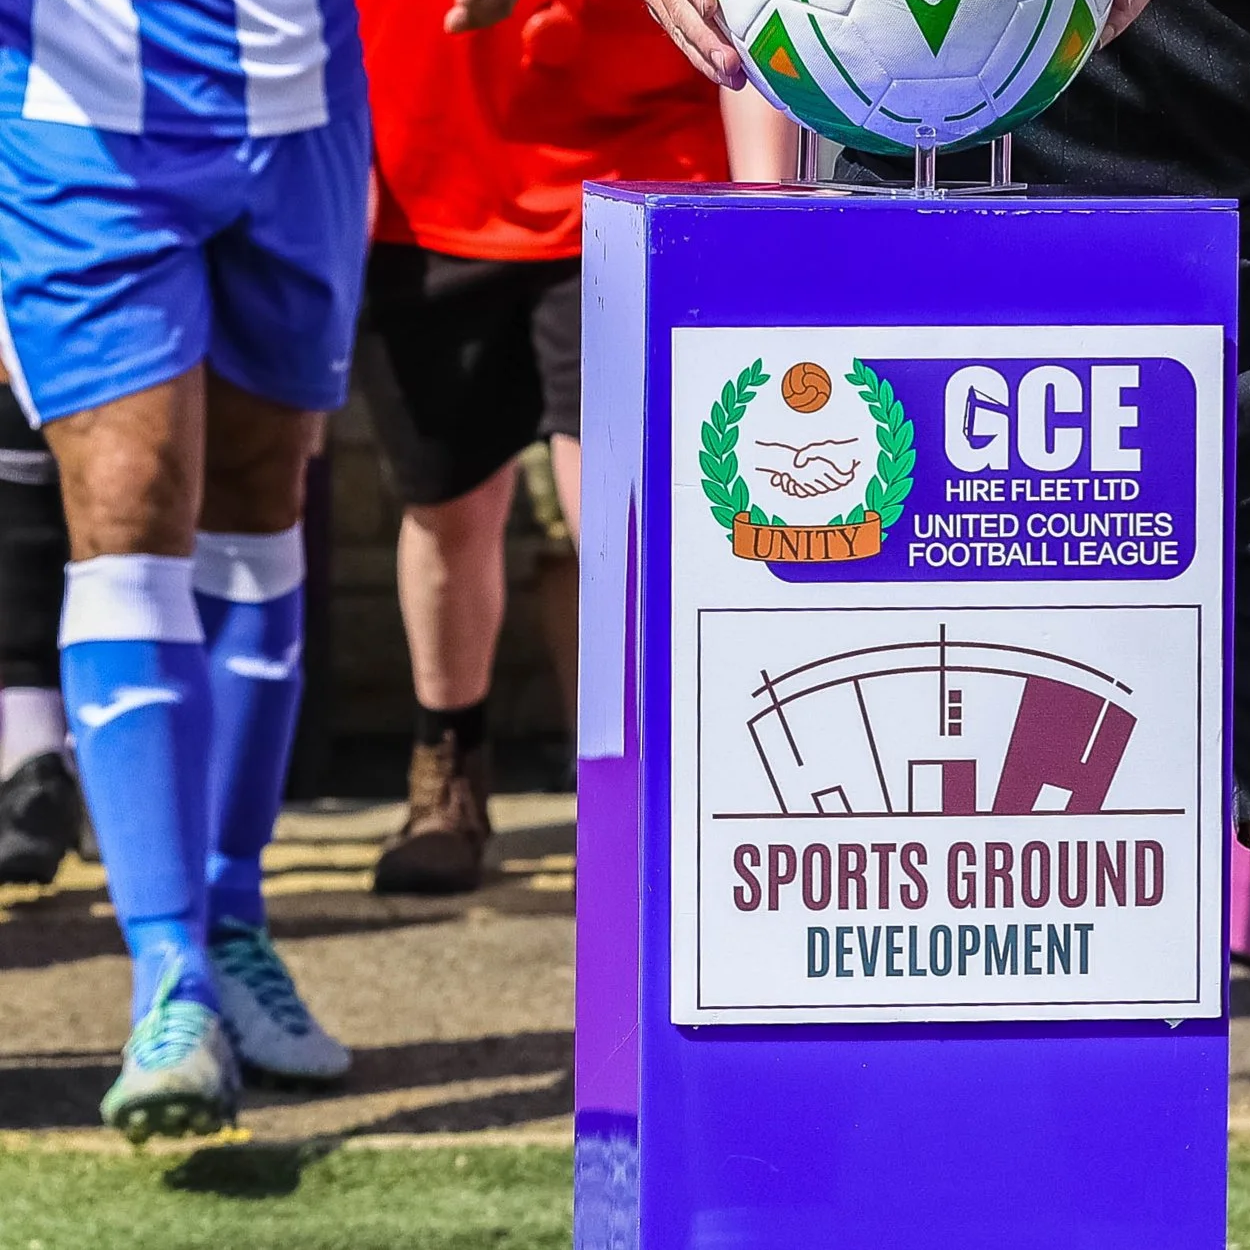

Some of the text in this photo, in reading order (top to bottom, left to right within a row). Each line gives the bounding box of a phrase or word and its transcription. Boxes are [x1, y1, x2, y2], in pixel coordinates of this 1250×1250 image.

[944, 365, 1142, 472] GCE
[946, 479, 1140, 502] HIRE FLEET LTD
[914, 512, 1173, 538] UNITED COUNTIES
[753, 527, 861, 561] UNITY
[908, 541, 1178, 567] FOOTBALL LEAGUE
[732, 840, 1164, 911] SPORTS GROUND
[806, 923, 1094, 978] DEVELOPMENT
